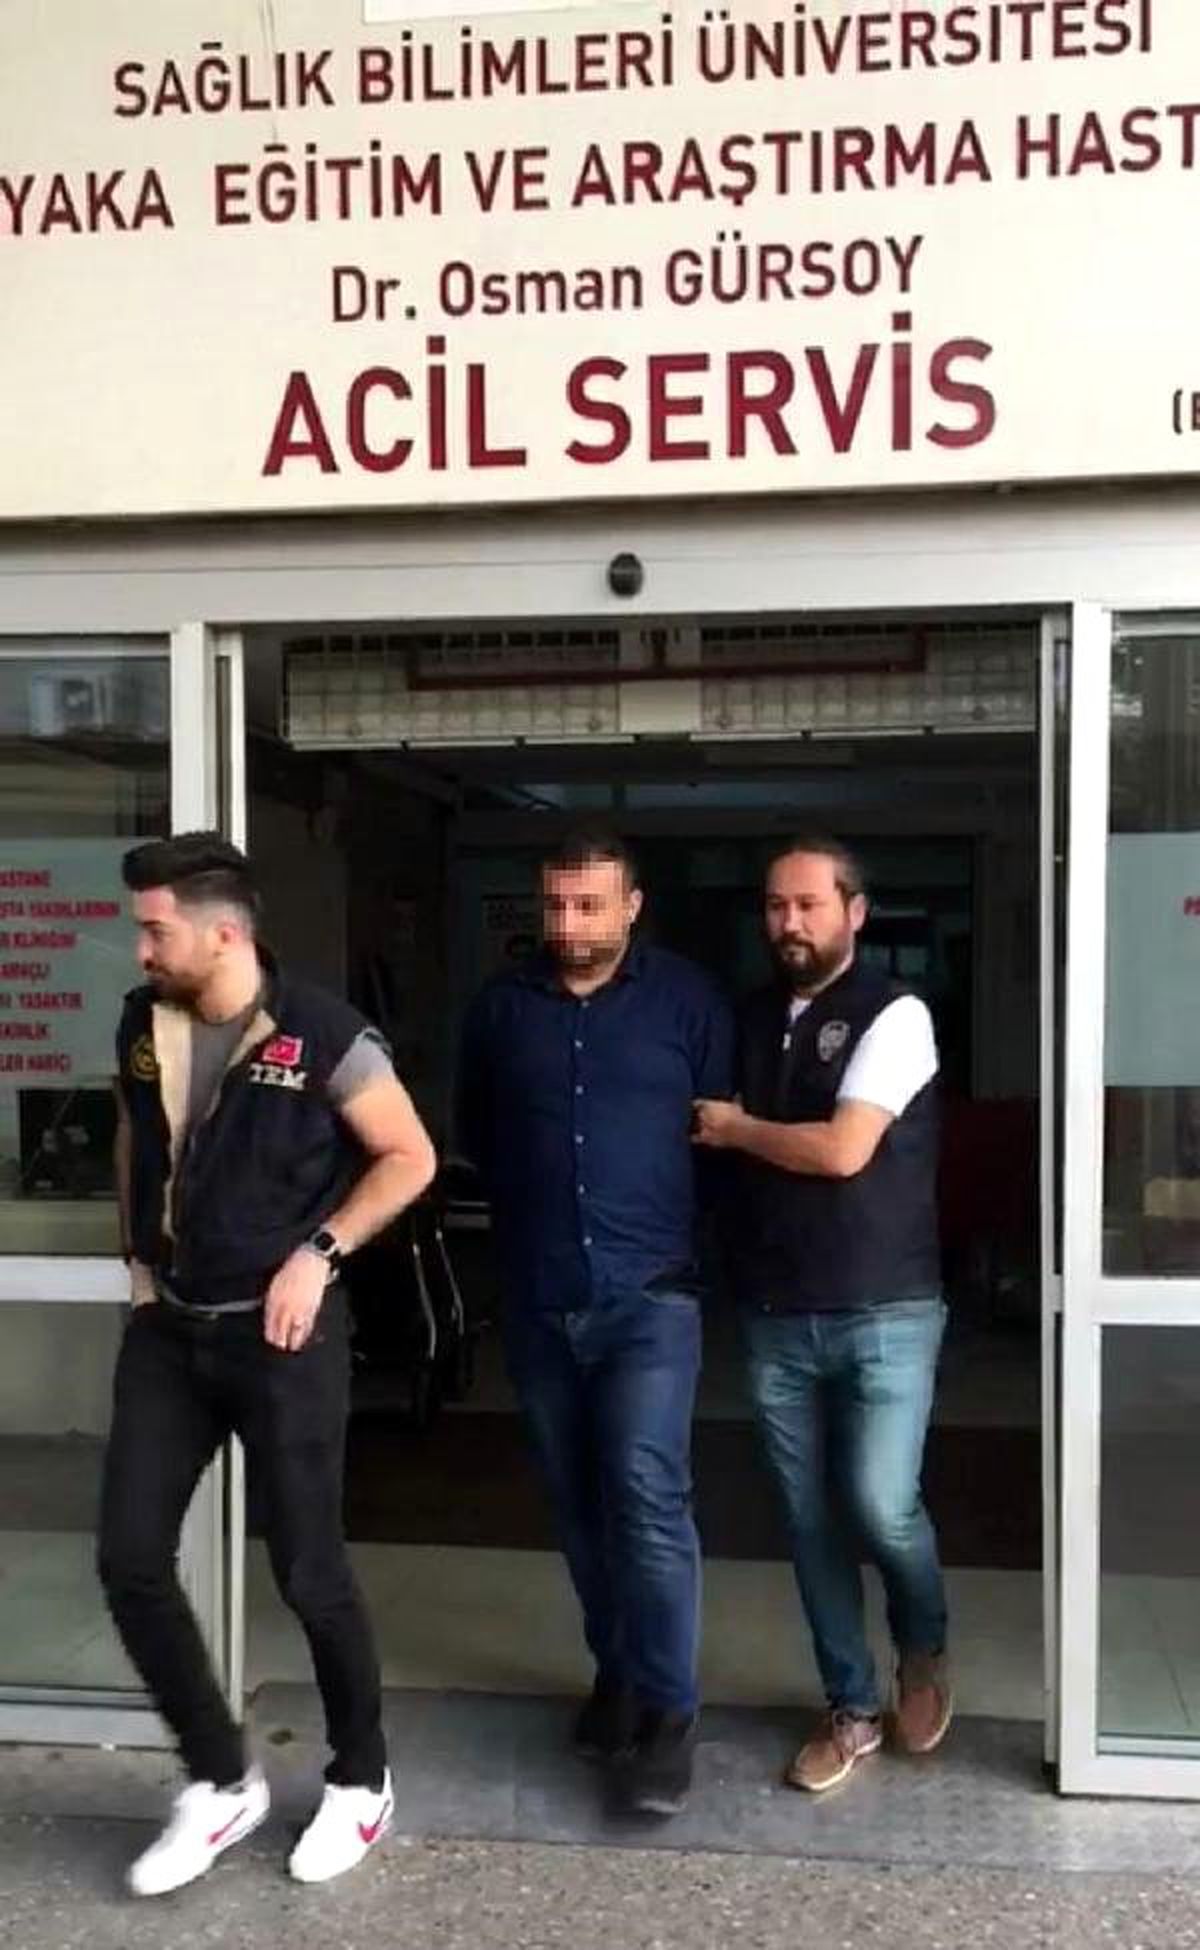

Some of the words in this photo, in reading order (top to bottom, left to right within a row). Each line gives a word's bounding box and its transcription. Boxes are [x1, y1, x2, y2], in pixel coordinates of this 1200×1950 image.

[114, 42, 335, 118] SAĞLIK
[359, 14, 673, 104] BİLİMLERİ
[0, 169, 174, 235] YAKA
[215, 140, 442, 226] EĞİTİM
[465, 148, 549, 212] VE
[571, 119, 992, 207] ARAŞTIRMA
[332, 266, 416, 322] Dr.
[439, 261, 642, 317] Osman
[665, 231, 923, 306] GÜRSOY
[262, 336, 527, 477] ACİL
[565, 311, 996, 465] SERVİS
[250, 1063, 306, 1090] TEM
